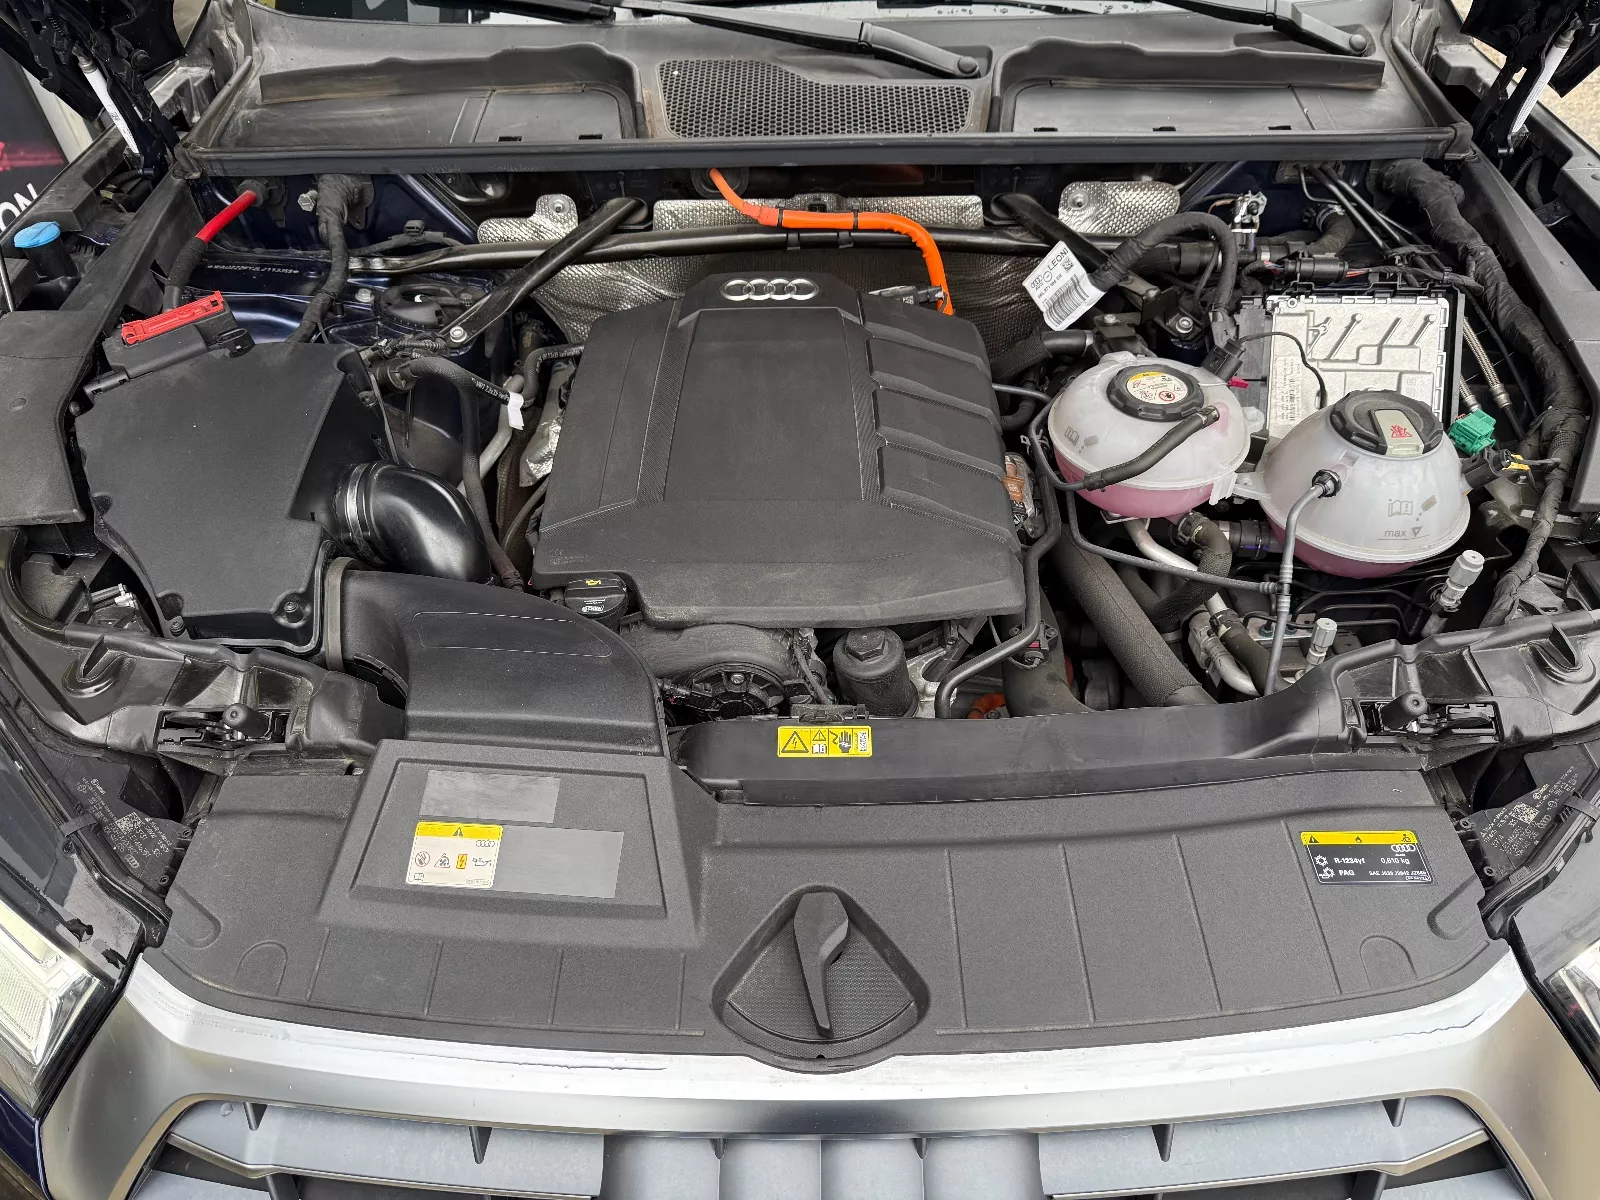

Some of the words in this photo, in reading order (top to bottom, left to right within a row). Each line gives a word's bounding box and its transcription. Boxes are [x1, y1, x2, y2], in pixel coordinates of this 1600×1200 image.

[1048, 247, 1069, 271] LEONI
[1384, 530, 1407, 538] max
[1333, 857, 1365, 865] R-1234yf
[1381, 857, 1399, 865] 0,610
